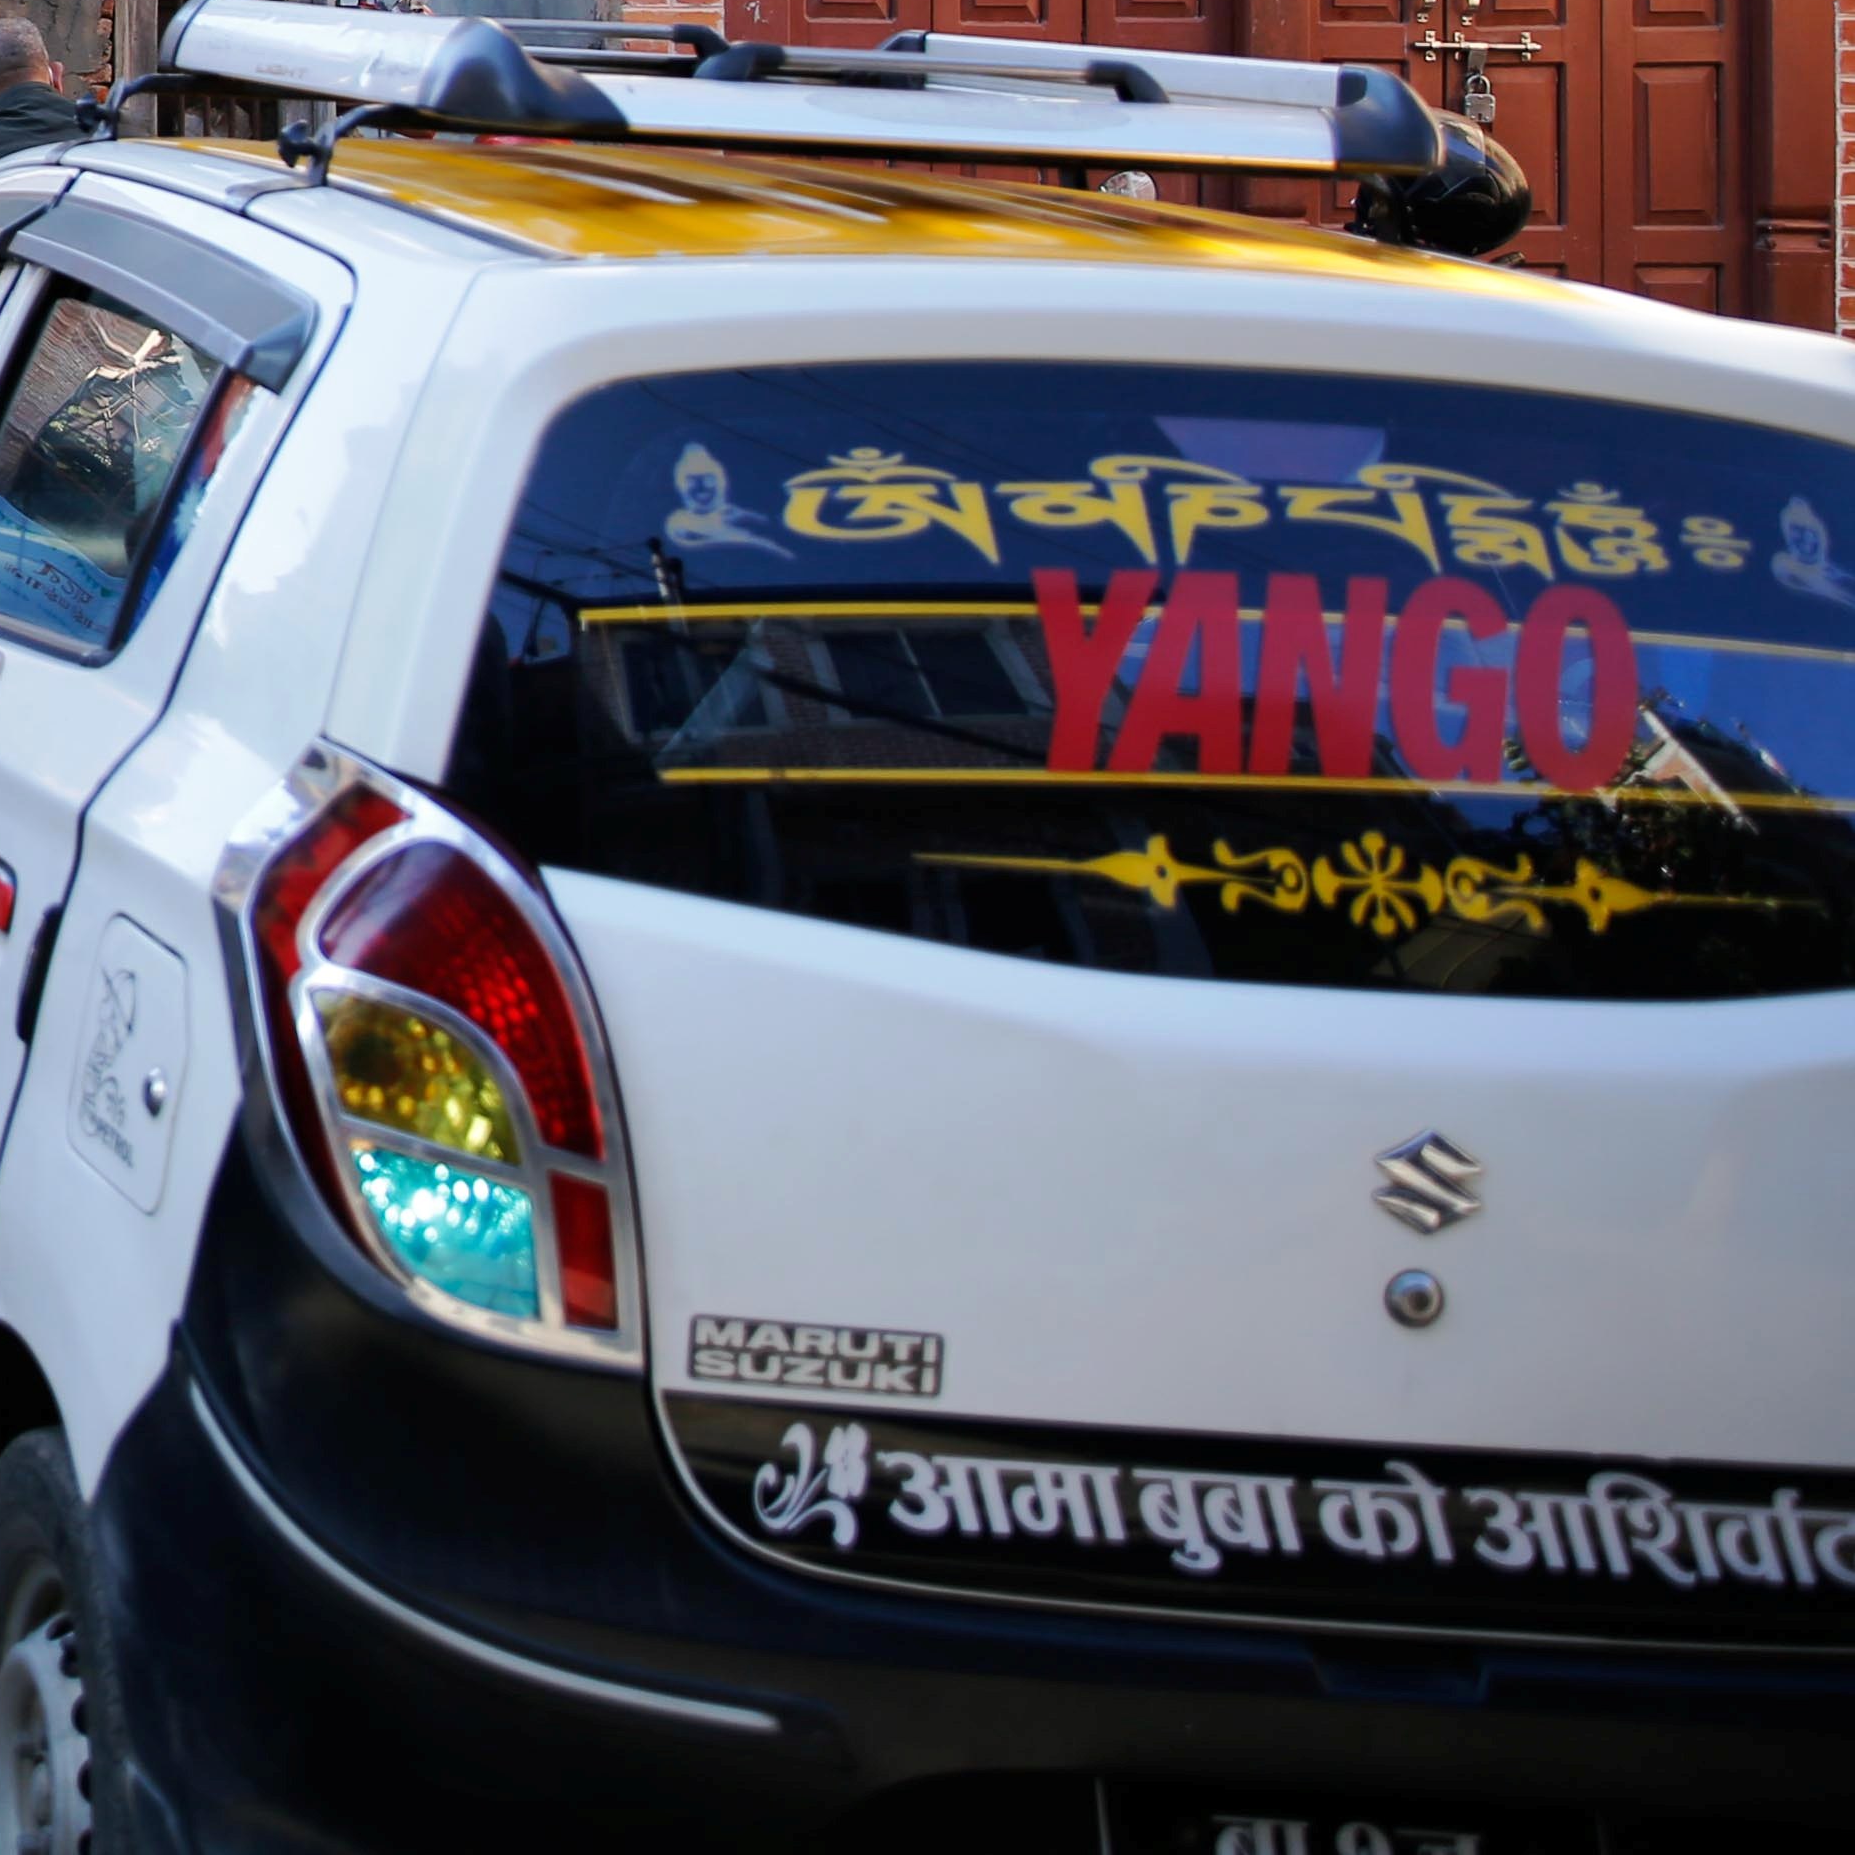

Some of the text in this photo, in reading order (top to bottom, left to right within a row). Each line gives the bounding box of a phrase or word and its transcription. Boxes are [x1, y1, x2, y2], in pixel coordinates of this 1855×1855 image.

[1033, 565, 1638, 794] YANGO
[693, 1349, 936, 1394] SUZUKI
[695, 1317, 937, 1364] MARUTI
[876, 1448, 1129, 1546] आमा
[1135, 1464, 1304, 1576] बुबा
[1316, 1461, 1456, 1566] को
